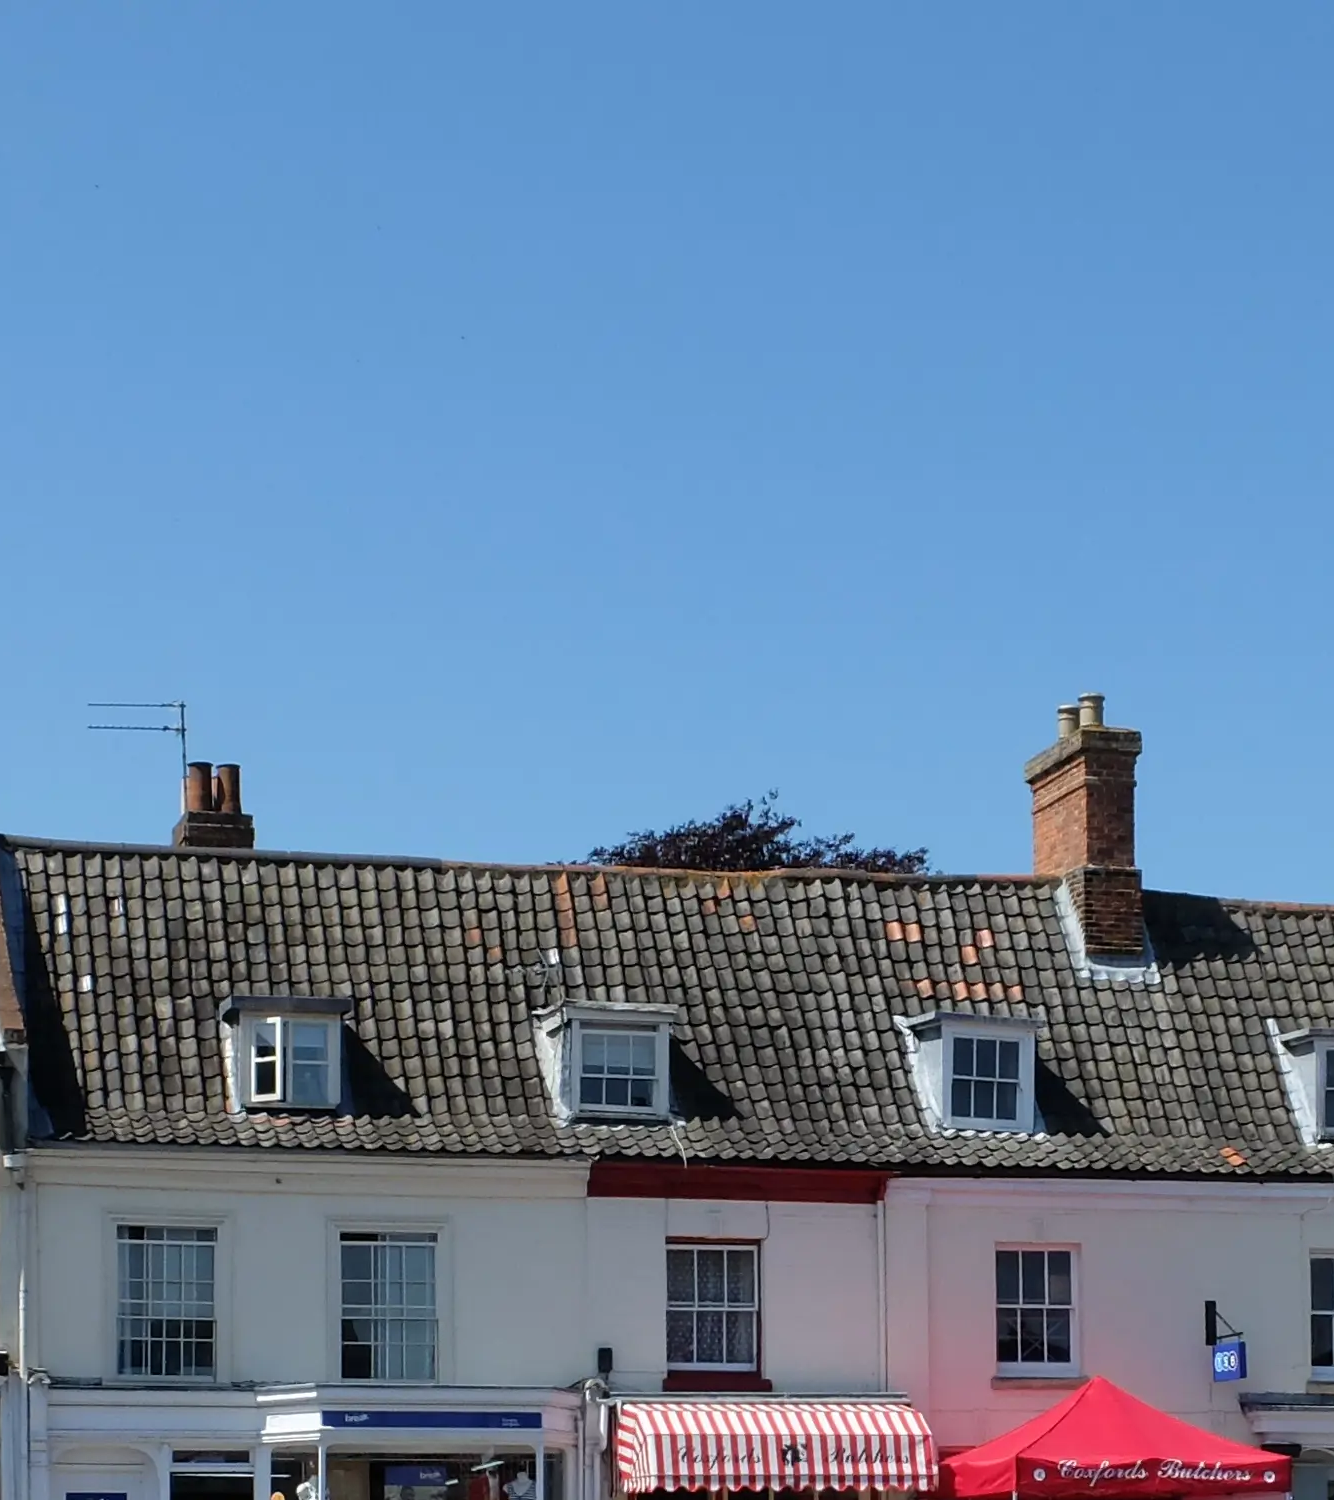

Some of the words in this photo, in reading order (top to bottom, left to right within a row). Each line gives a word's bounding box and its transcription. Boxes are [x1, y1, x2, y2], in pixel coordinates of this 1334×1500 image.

[1215, 1352, 1238, 1371] TSB
[344, 1413, 369, 1423] break
[1057, 1458, 1149, 1487] Coxfords
[1157, 1458, 1252, 1481] Butchers
